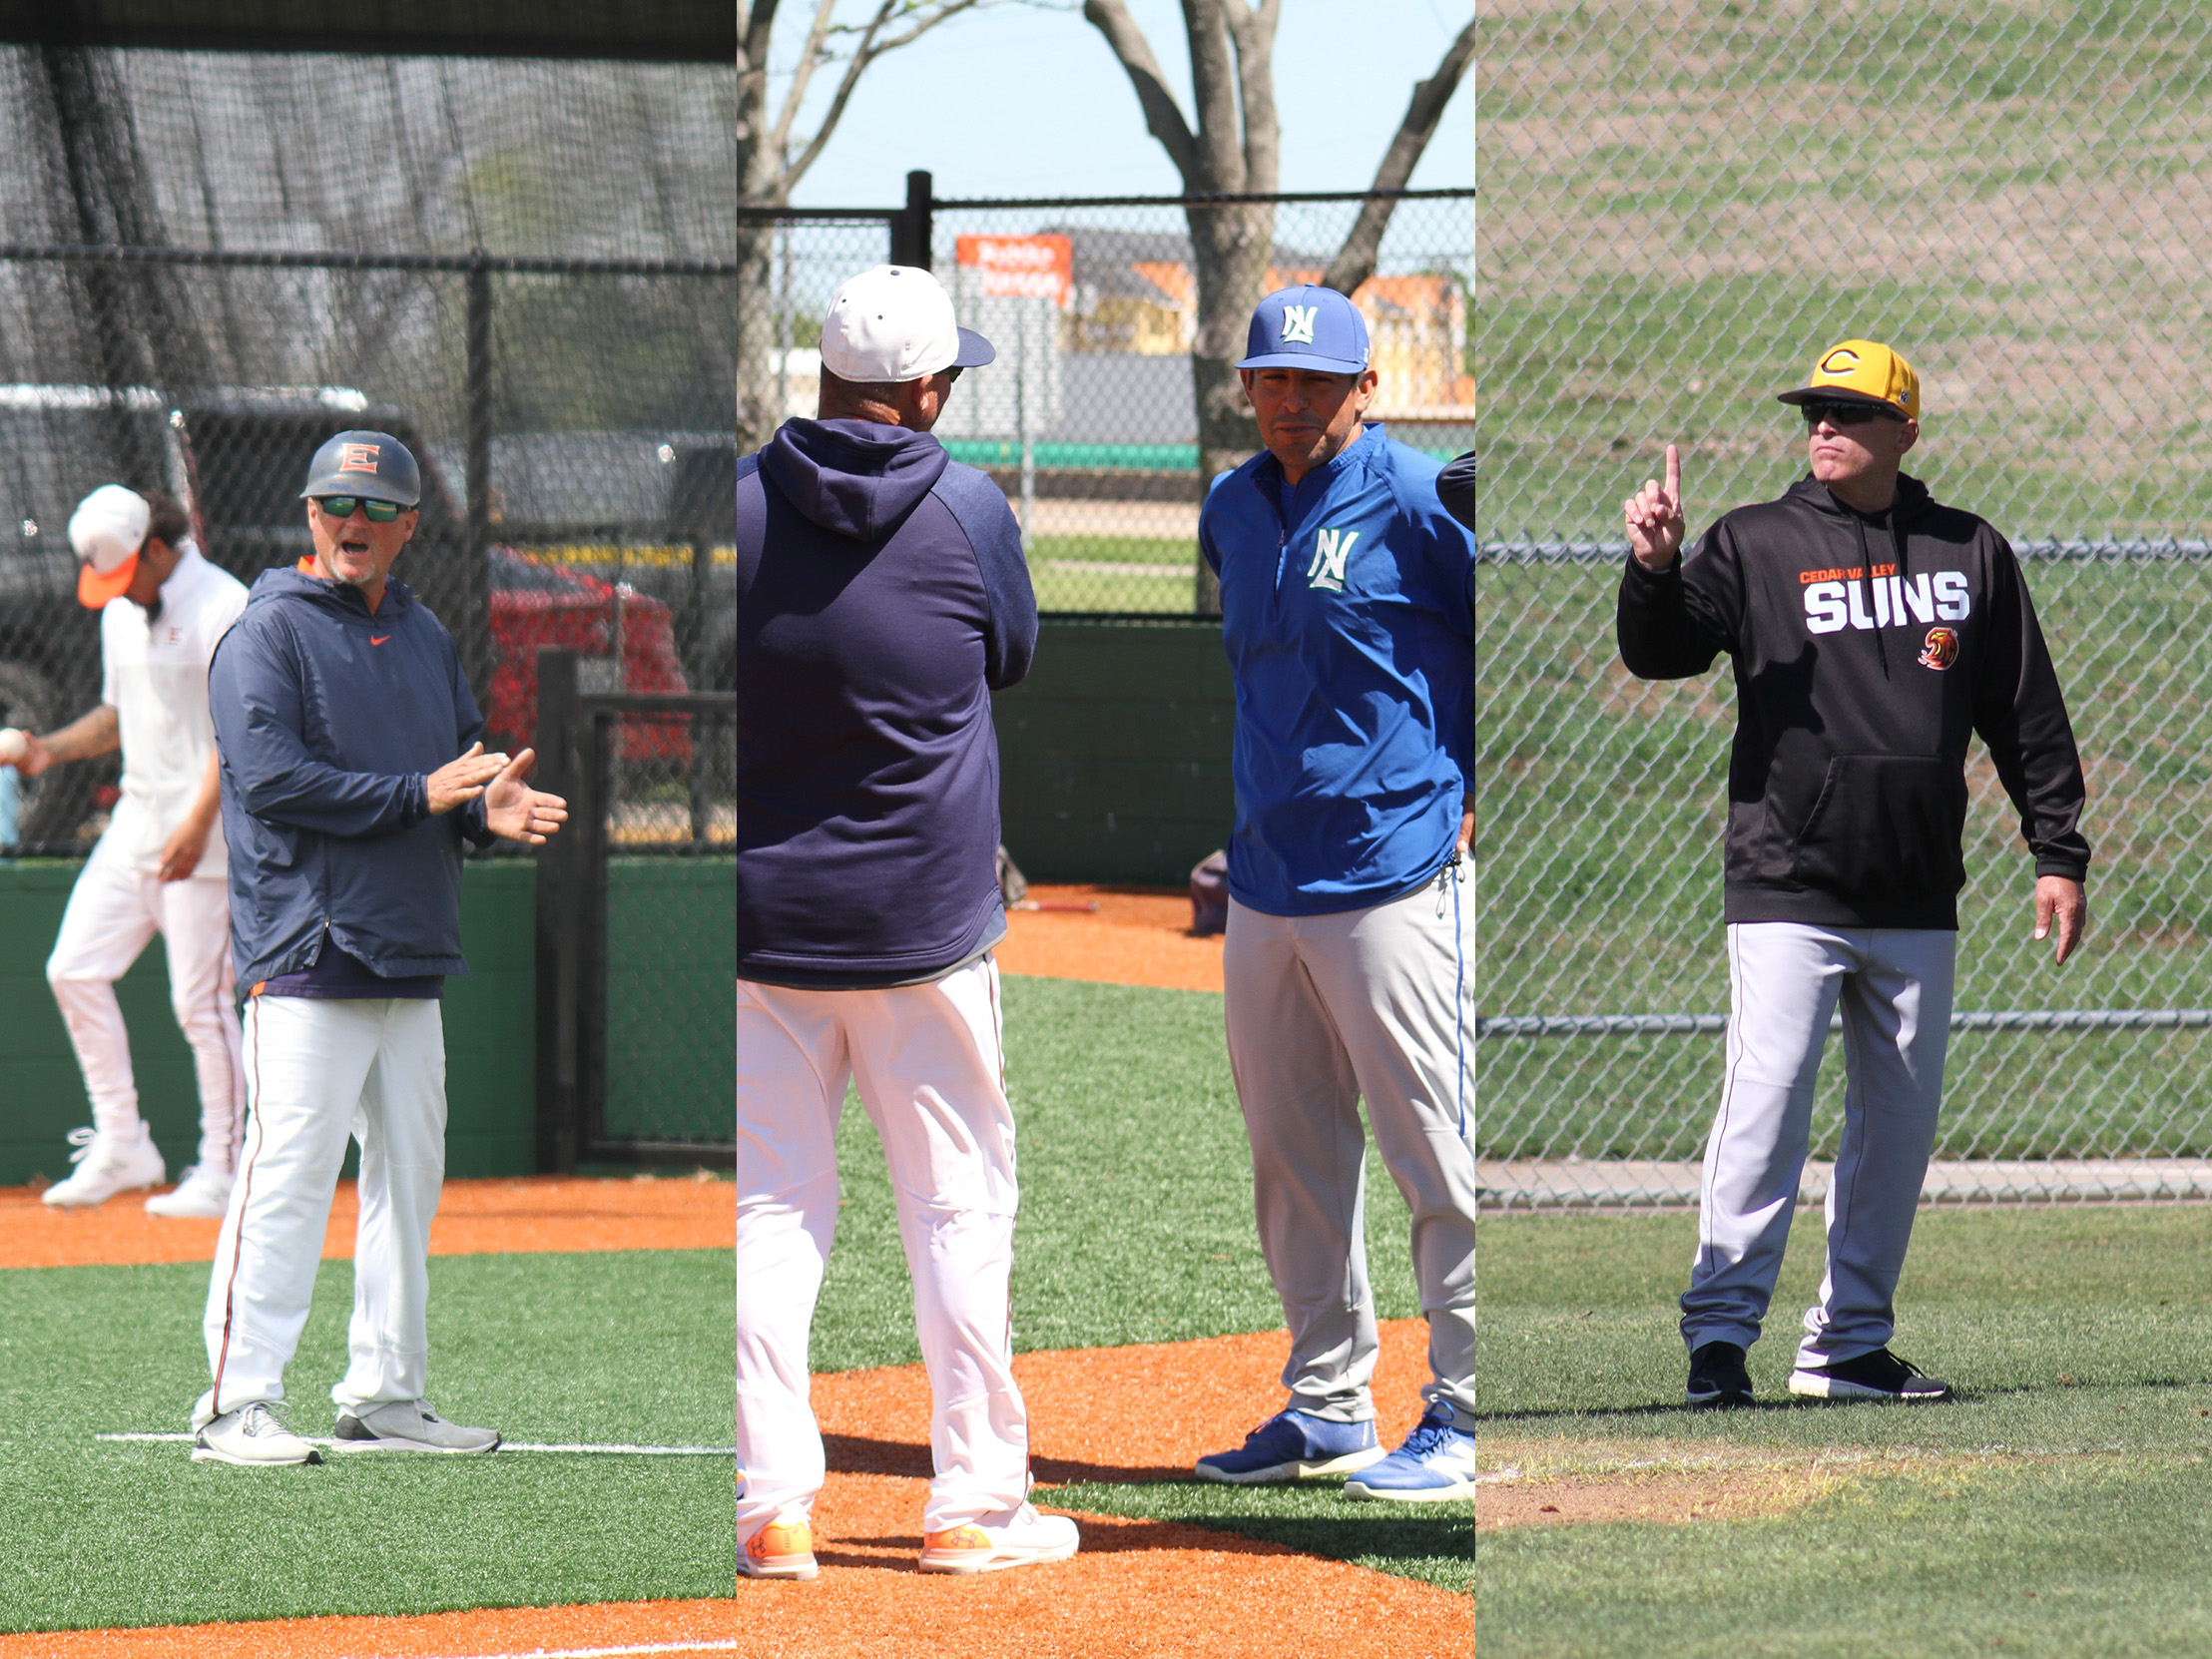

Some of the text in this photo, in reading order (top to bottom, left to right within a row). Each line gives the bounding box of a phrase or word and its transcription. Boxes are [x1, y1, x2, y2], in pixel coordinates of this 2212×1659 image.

[1821, 348, 1861, 377] C
[339, 443, 380, 474] E
[1800, 563, 1896, 584] CEDAR VALEY
[1804, 571, 1970, 635] SUNS
